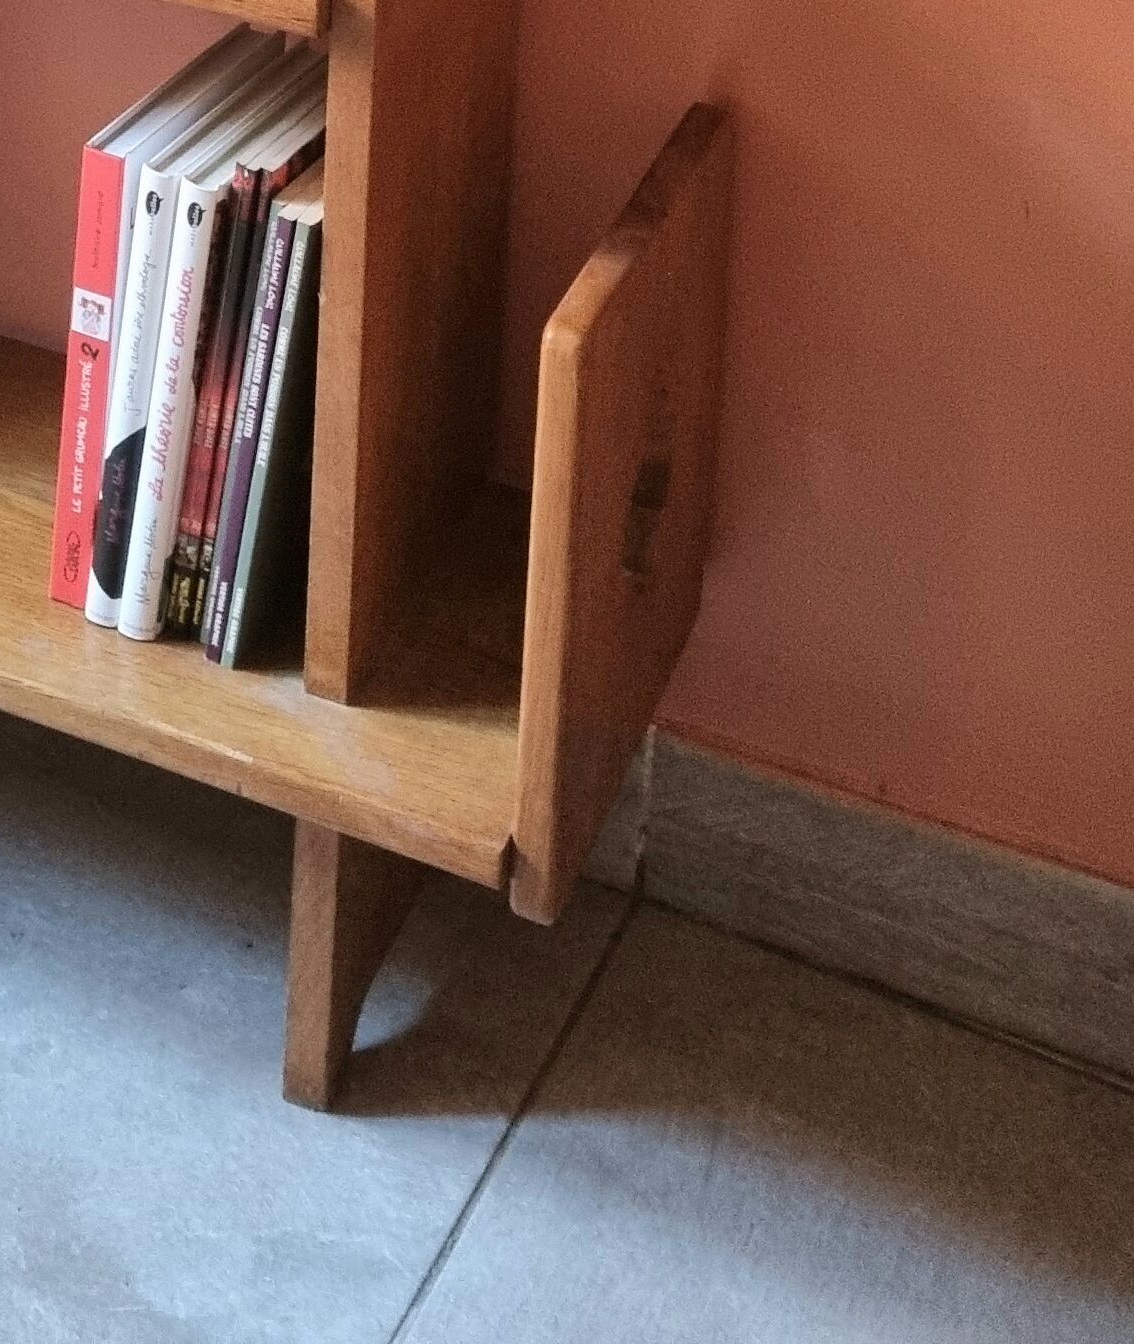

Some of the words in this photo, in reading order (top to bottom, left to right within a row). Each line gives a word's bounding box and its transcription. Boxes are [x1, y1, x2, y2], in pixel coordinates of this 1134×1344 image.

[71, 498, 81, 513] LE
[80, 342, 99, 360] 2
[151, 402, 175, 471] théorie
[170, 269, 193, 347] contorsion
